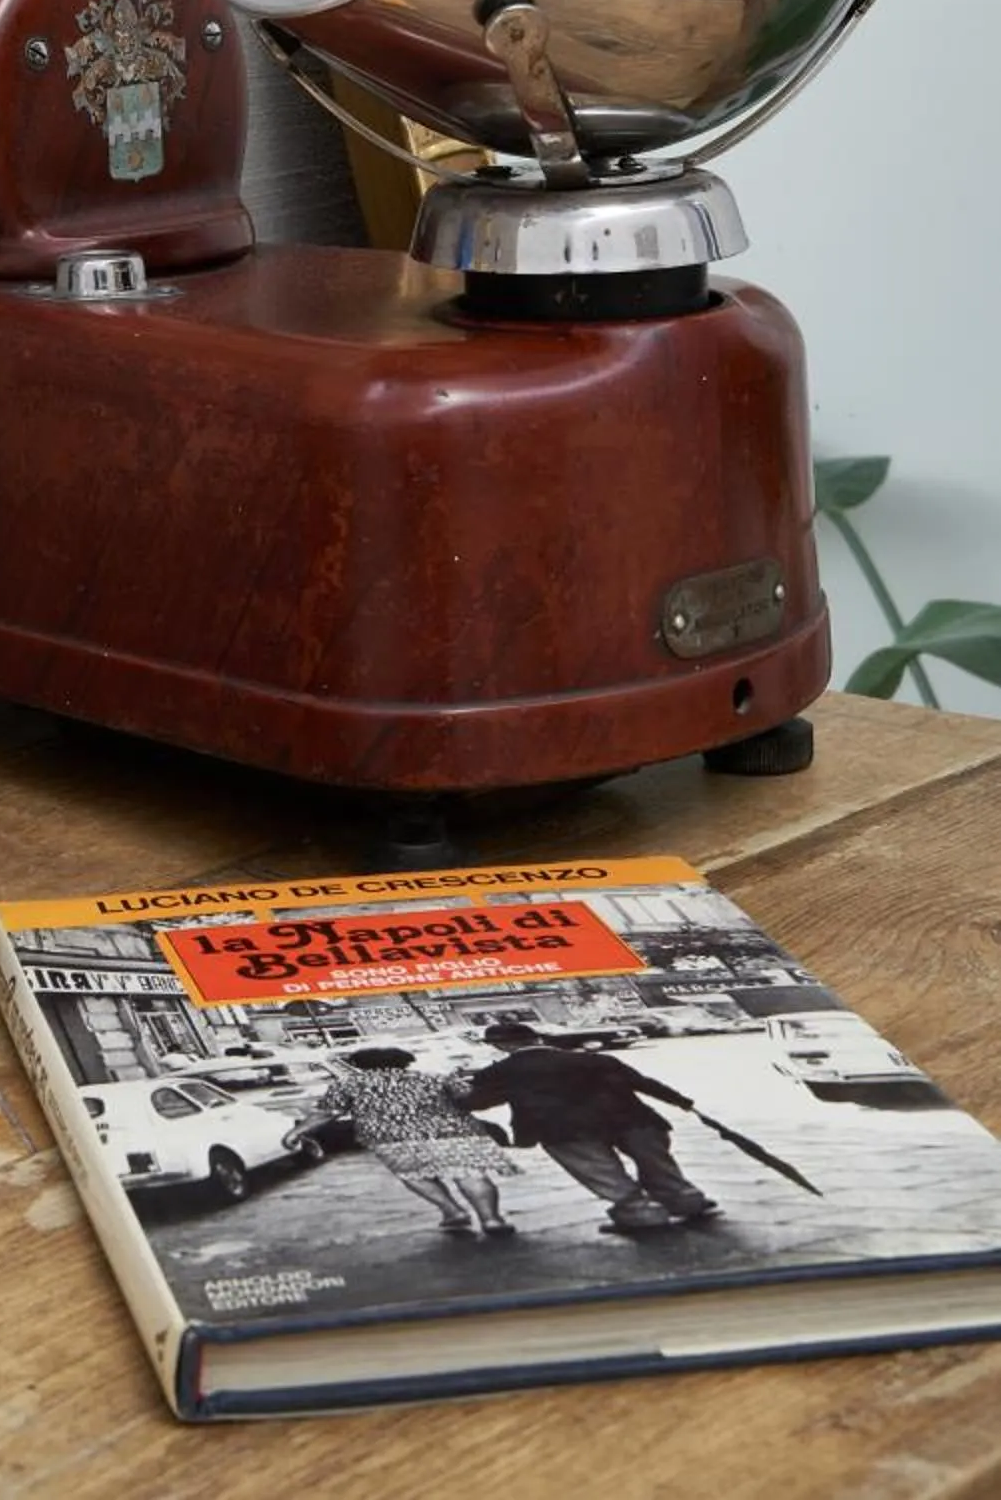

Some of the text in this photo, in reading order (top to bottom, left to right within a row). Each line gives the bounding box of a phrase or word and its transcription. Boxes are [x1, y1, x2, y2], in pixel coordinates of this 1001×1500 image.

[96, 866, 608, 915] LUCIANO DE CRESCENZO
[193, 908, 581, 955] la Napoli di
[236, 933, 574, 980] Bellavista
[330, 956, 503, 980] SONO FIGLIO
[282, 962, 562, 994] DI PERSONE ANTICHE
[204, 1269, 312, 1290] ARNOLDO
